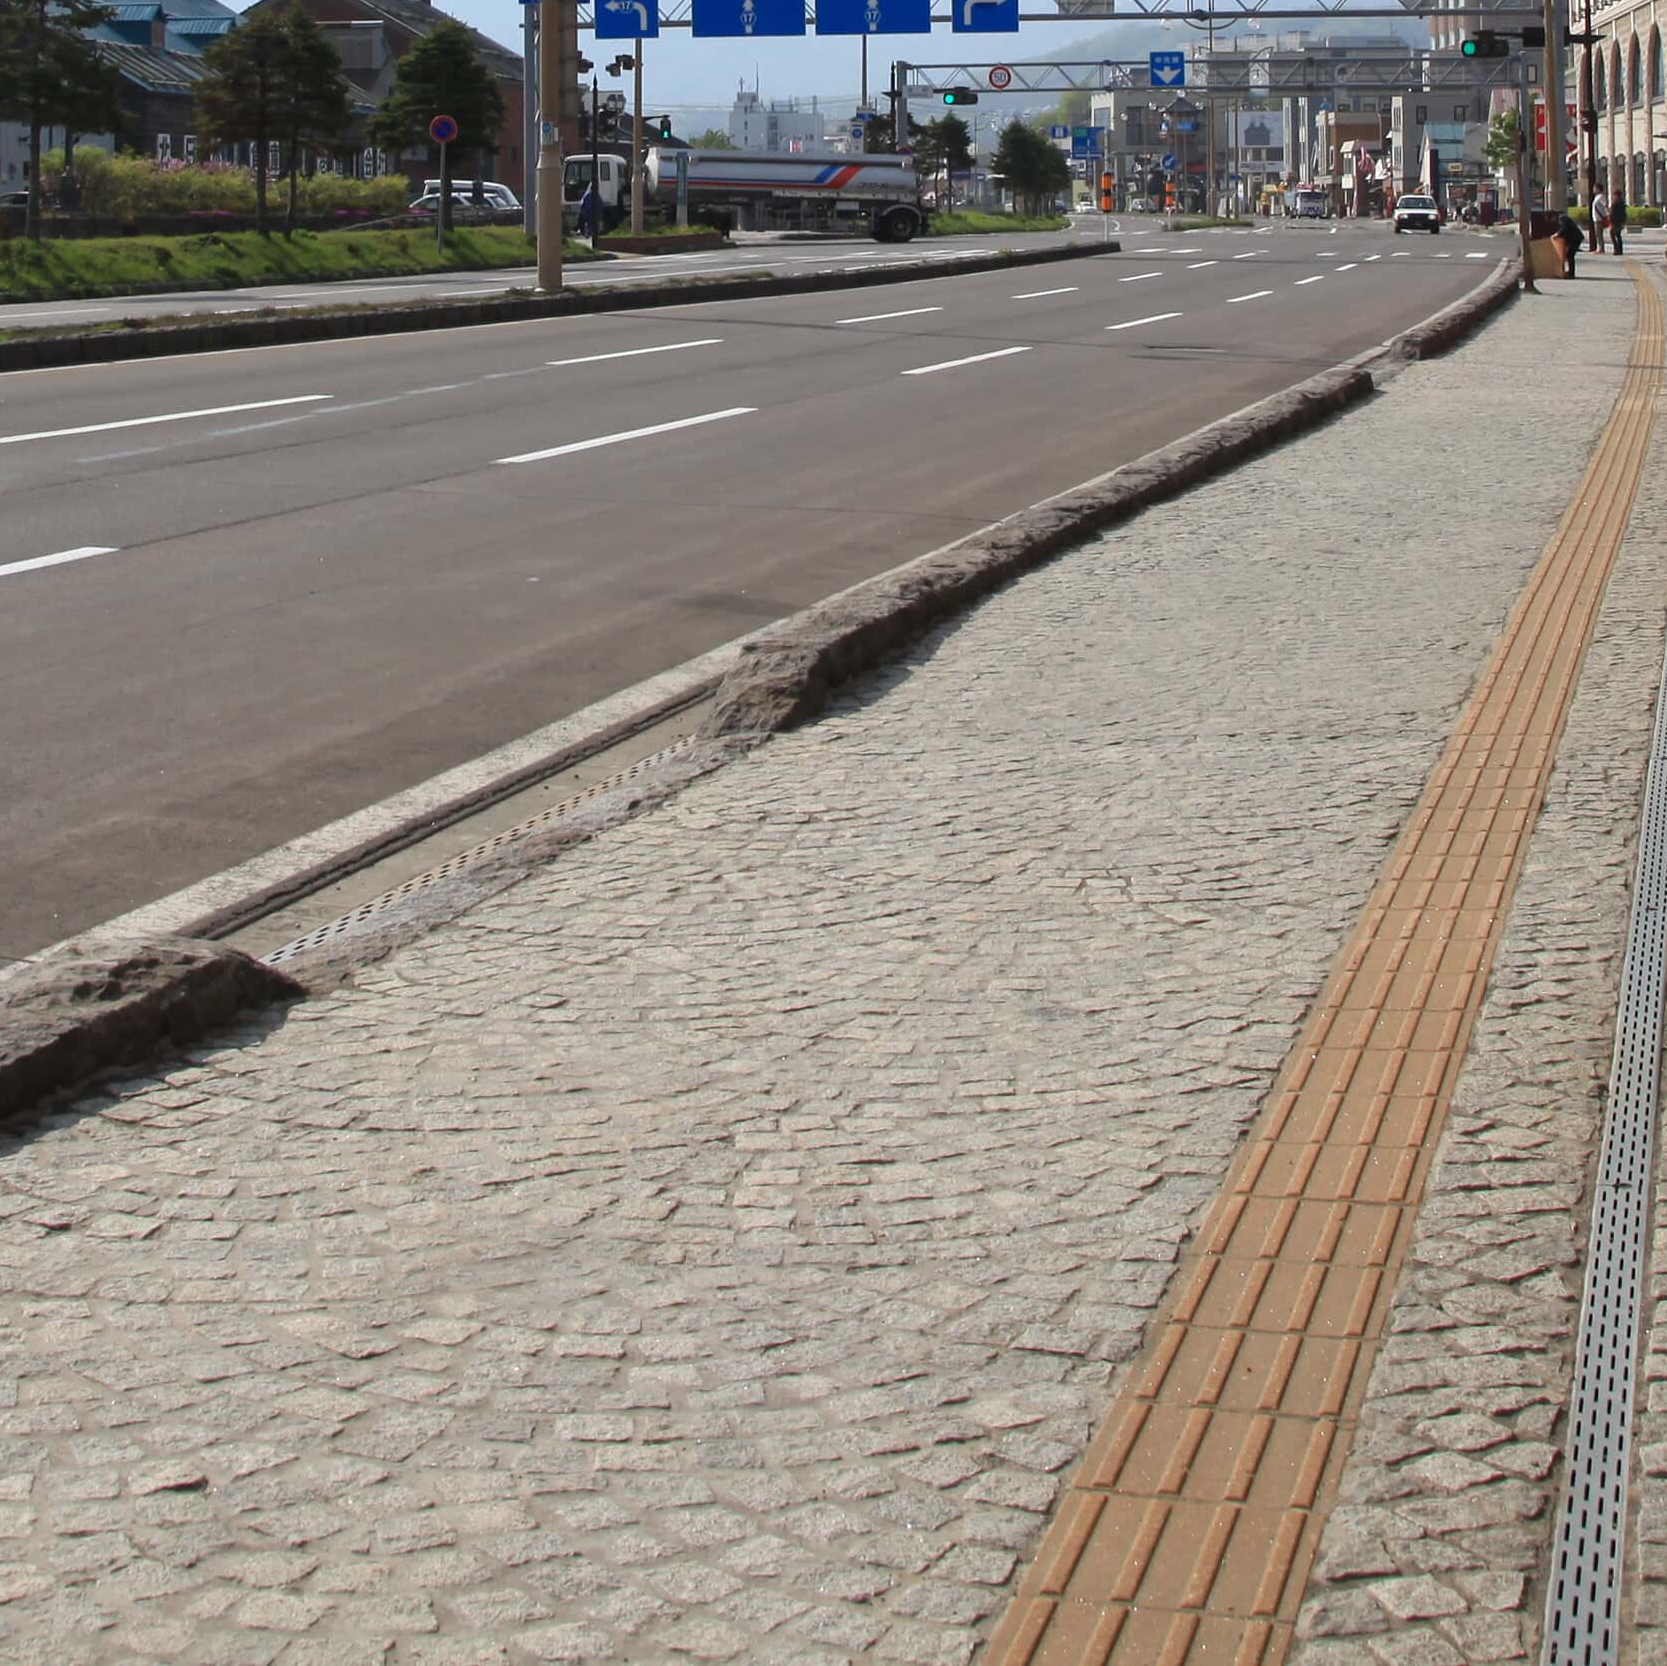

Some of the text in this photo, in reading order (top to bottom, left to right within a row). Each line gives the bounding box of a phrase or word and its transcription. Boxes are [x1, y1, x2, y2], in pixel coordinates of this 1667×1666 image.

[620, 0, 631, 11] 17
[743, 13, 754, 23] 17
[867, 10, 878, 21] 17
[993, 72, 1007, 83] 50
